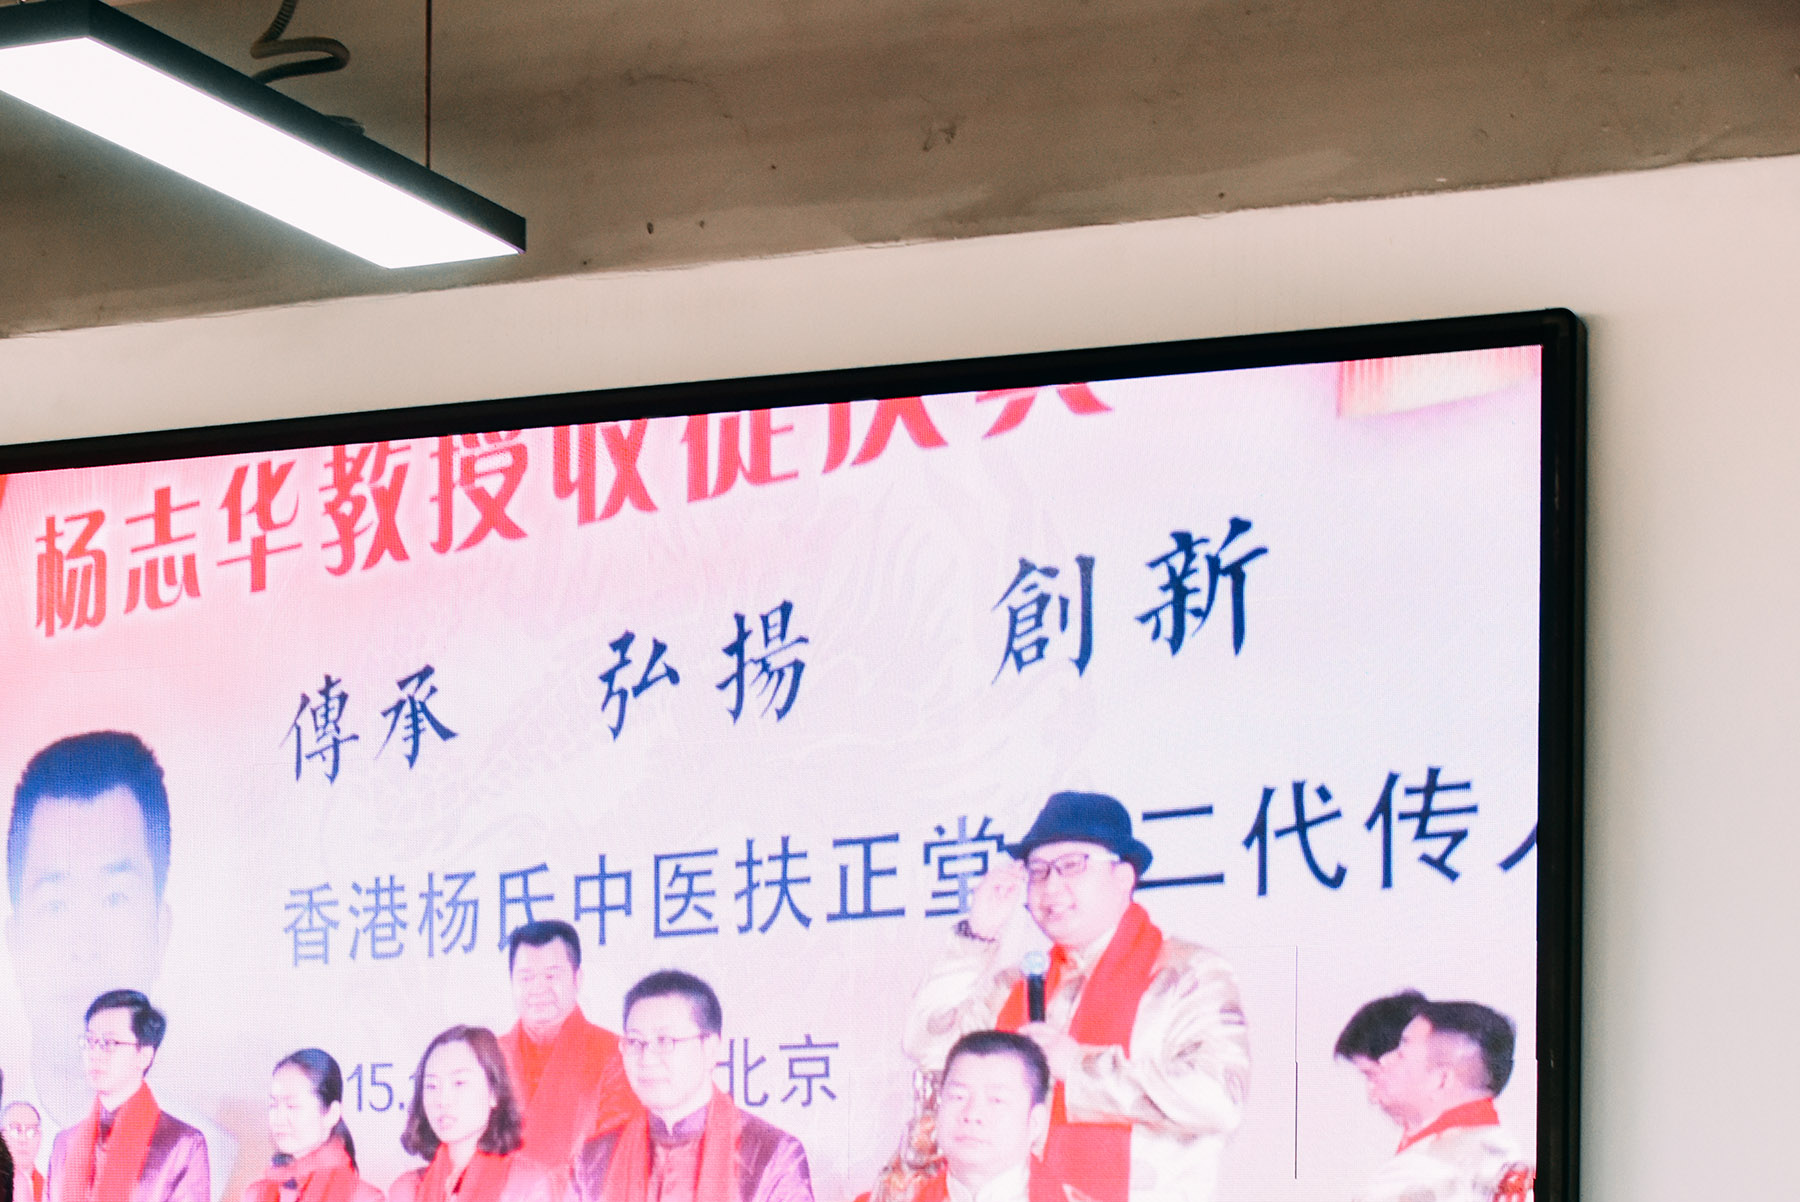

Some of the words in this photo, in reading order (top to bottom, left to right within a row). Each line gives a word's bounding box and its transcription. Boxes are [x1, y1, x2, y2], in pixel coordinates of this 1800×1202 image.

[280, 664, 458, 785] 傳承
[598, 599, 809, 742] 弘揚
[990, 516, 1269, 685] 創新
[284, 767, 1537, 967] 香港杨氏中医扶正堂二代传
[716, 1034, 839, 1107] 北京
